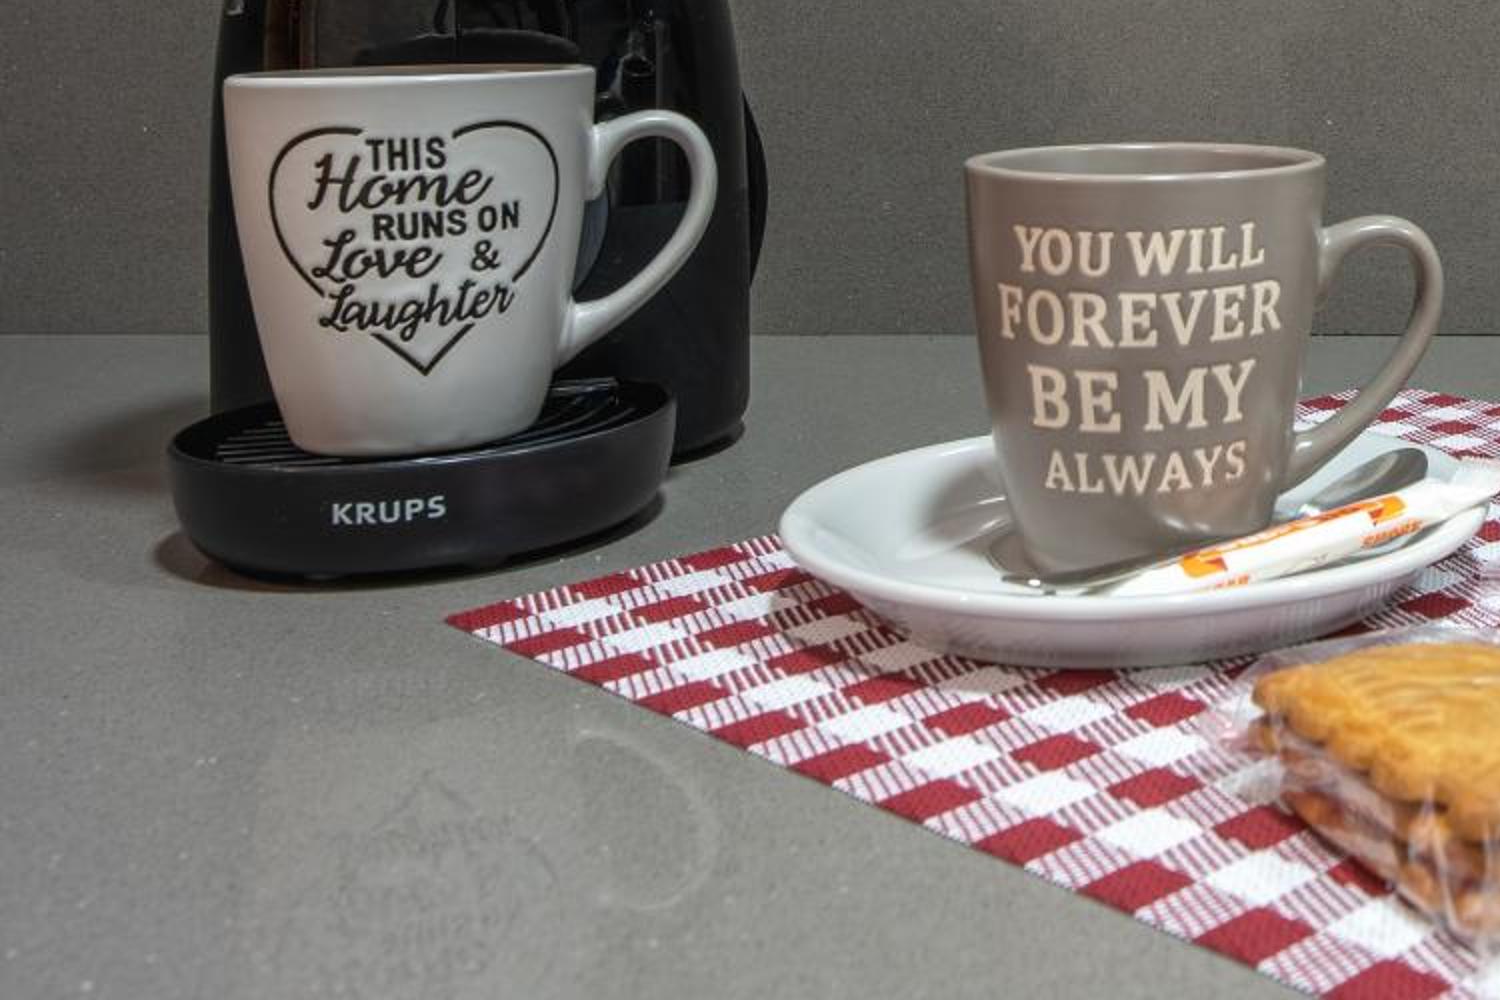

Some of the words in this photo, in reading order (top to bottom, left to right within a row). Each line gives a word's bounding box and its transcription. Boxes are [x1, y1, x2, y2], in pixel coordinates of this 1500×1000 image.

[365, 136, 447, 171] THIS
[307, 152, 494, 213] Home
[373, 208, 467, 241] RUNS
[478, 200, 519, 232] ON
[311, 229, 443, 283] Love
[470, 240, 501, 272] &
[1013, 224, 1115, 277] YOU
[1126, 221, 1265, 277] WILL
[319, 279, 515, 342] Laughter
[997, 279, 1281, 348] FOREVER
[1027, 363, 1122, 433] BE
[1143, 359, 1257, 432] MY
[1045, 440, 1247, 496] ALWAYS
[331, 495, 447, 525] KRUPS
